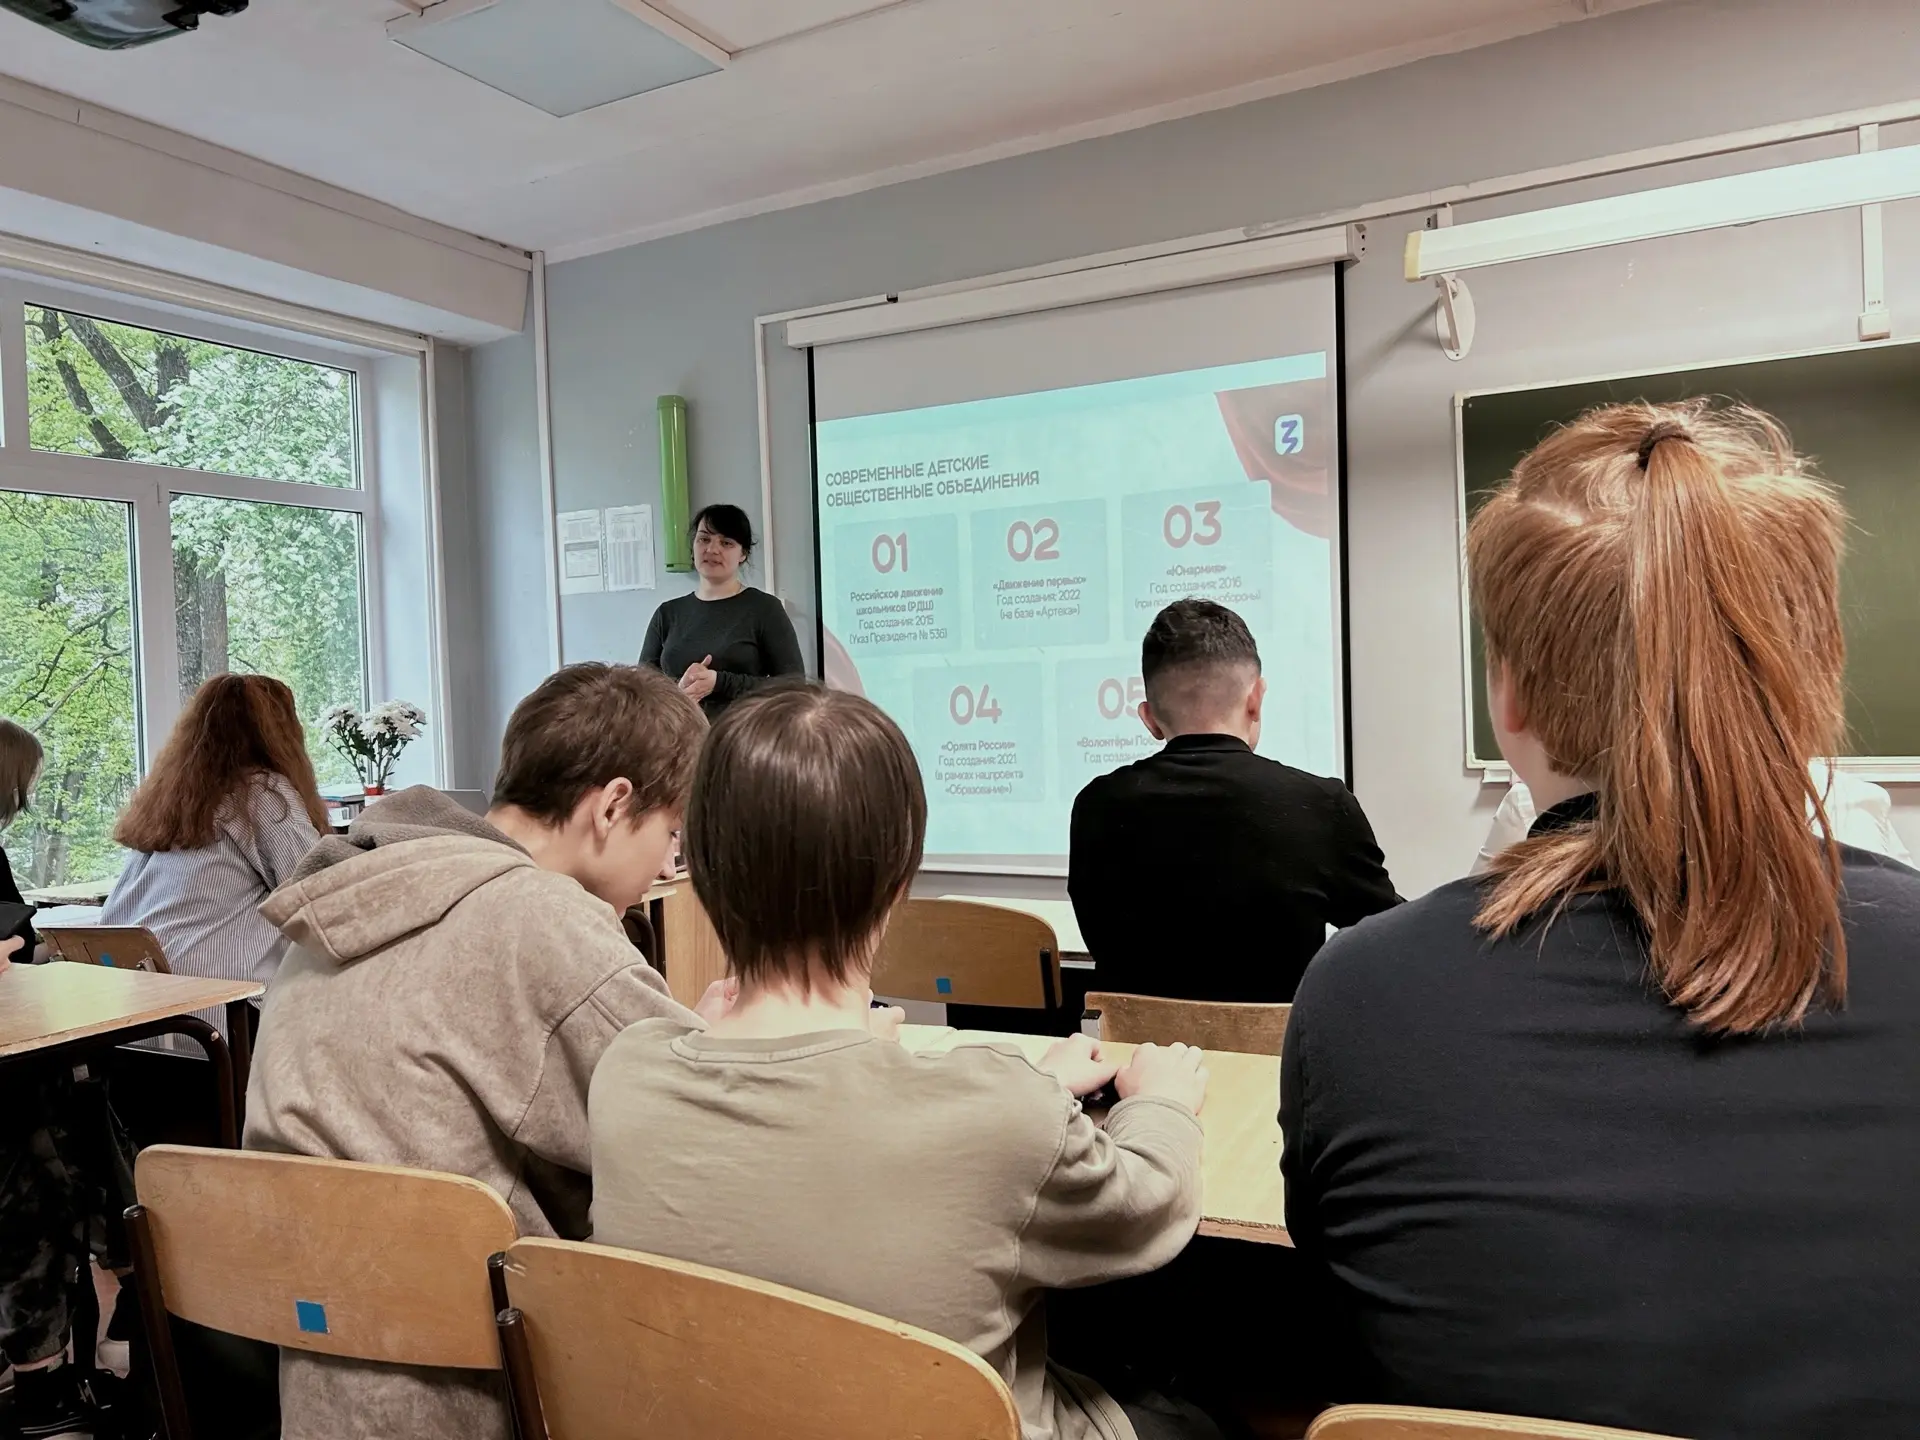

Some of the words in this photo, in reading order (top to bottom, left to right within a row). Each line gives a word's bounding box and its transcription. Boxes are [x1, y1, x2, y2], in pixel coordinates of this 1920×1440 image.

[825, 462, 924, 487] СОВРЕМЕННЫЕ
[927, 454, 989, 478] ДЕТСКИЕ
[826, 483, 933, 507] ОБЩЕСТВЕННЫЕ
[936, 470, 1039, 495] ОБЪЕДИНЕНИЯ
[1163, 500, 1222, 549] 03
[1007, 518, 1060, 562] 02
[871, 531, 908, 574] 01
[1166, 564, 1227, 577] «Юнармия»
[993, 579, 1045, 591] «Движение
[1046, 576, 1086, 588] первых»
[1149, 582, 1168, 594] Год
[1218, 576, 1242, 589] 2016
[850, 589, 899, 602] Российское
[901, 587, 943, 599] движение
[996, 594, 1014, 606] Год
[1058, 589, 1081, 601] 2022
[856, 604, 906, 615] школьников
[907, 600, 934, 613] (РДШ)
[1000, 608, 1013, 620] (на
[1014, 607, 1034, 619] базе
[859, 619, 874, 630] Год
[915, 615, 934, 626] 2015
[849, 633, 869, 645] (Указ
[870, 631, 918, 644] Президента
[949, 684, 1003, 725] 04
[1097, 676, 1146, 720] 05
[941, 741, 977, 754] «Орлята
[978, 740, 1015, 751] России»
[938, 755, 955, 767] Год
[997, 753, 1017, 765] 2021
[1084, 752, 1102, 764] Год
[944, 771, 974, 783] рамках
[975, 770, 1024, 782] нацпроекта
